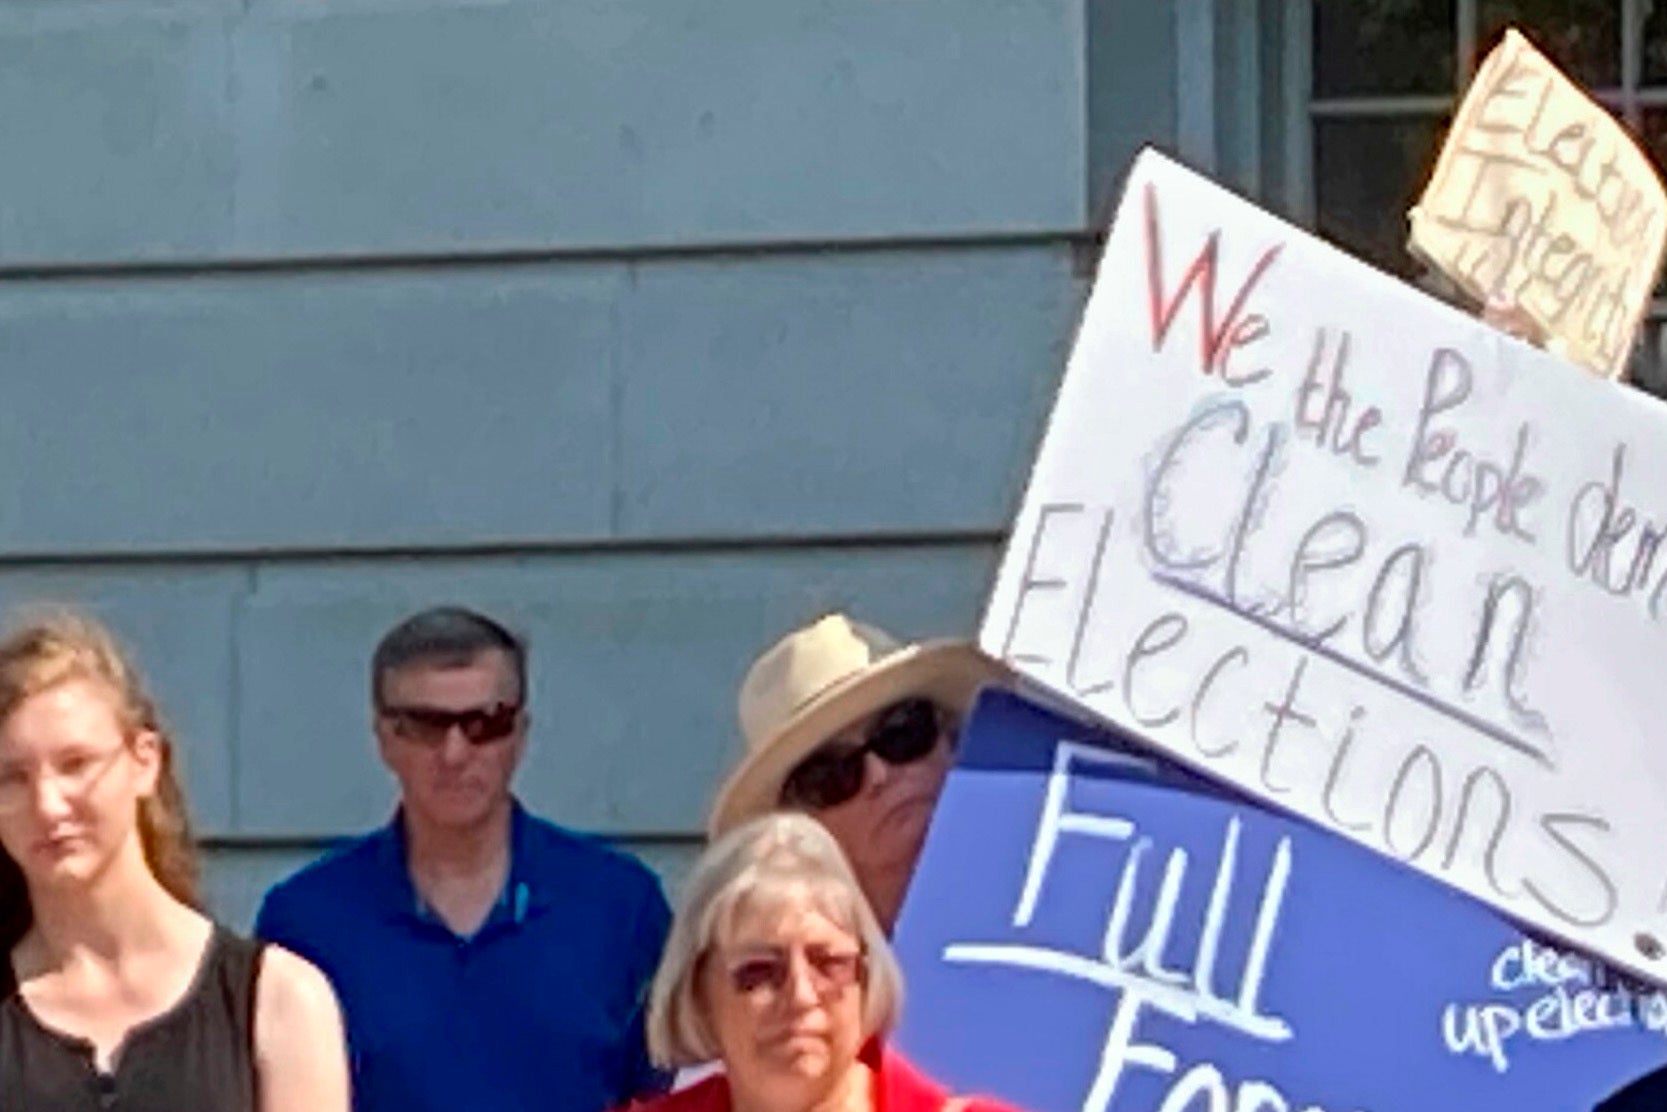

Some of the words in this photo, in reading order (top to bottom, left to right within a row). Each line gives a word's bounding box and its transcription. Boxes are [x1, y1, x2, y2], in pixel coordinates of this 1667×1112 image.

[1143, 184, 1286, 390] We
[1294, 327, 1383, 467] the
[1402, 347, 1546, 547] People
[1143, 390, 1550, 735] Clean
[1013, 740, 1293, 1025] Full
[1442, 1001, 1521, 1074] up
